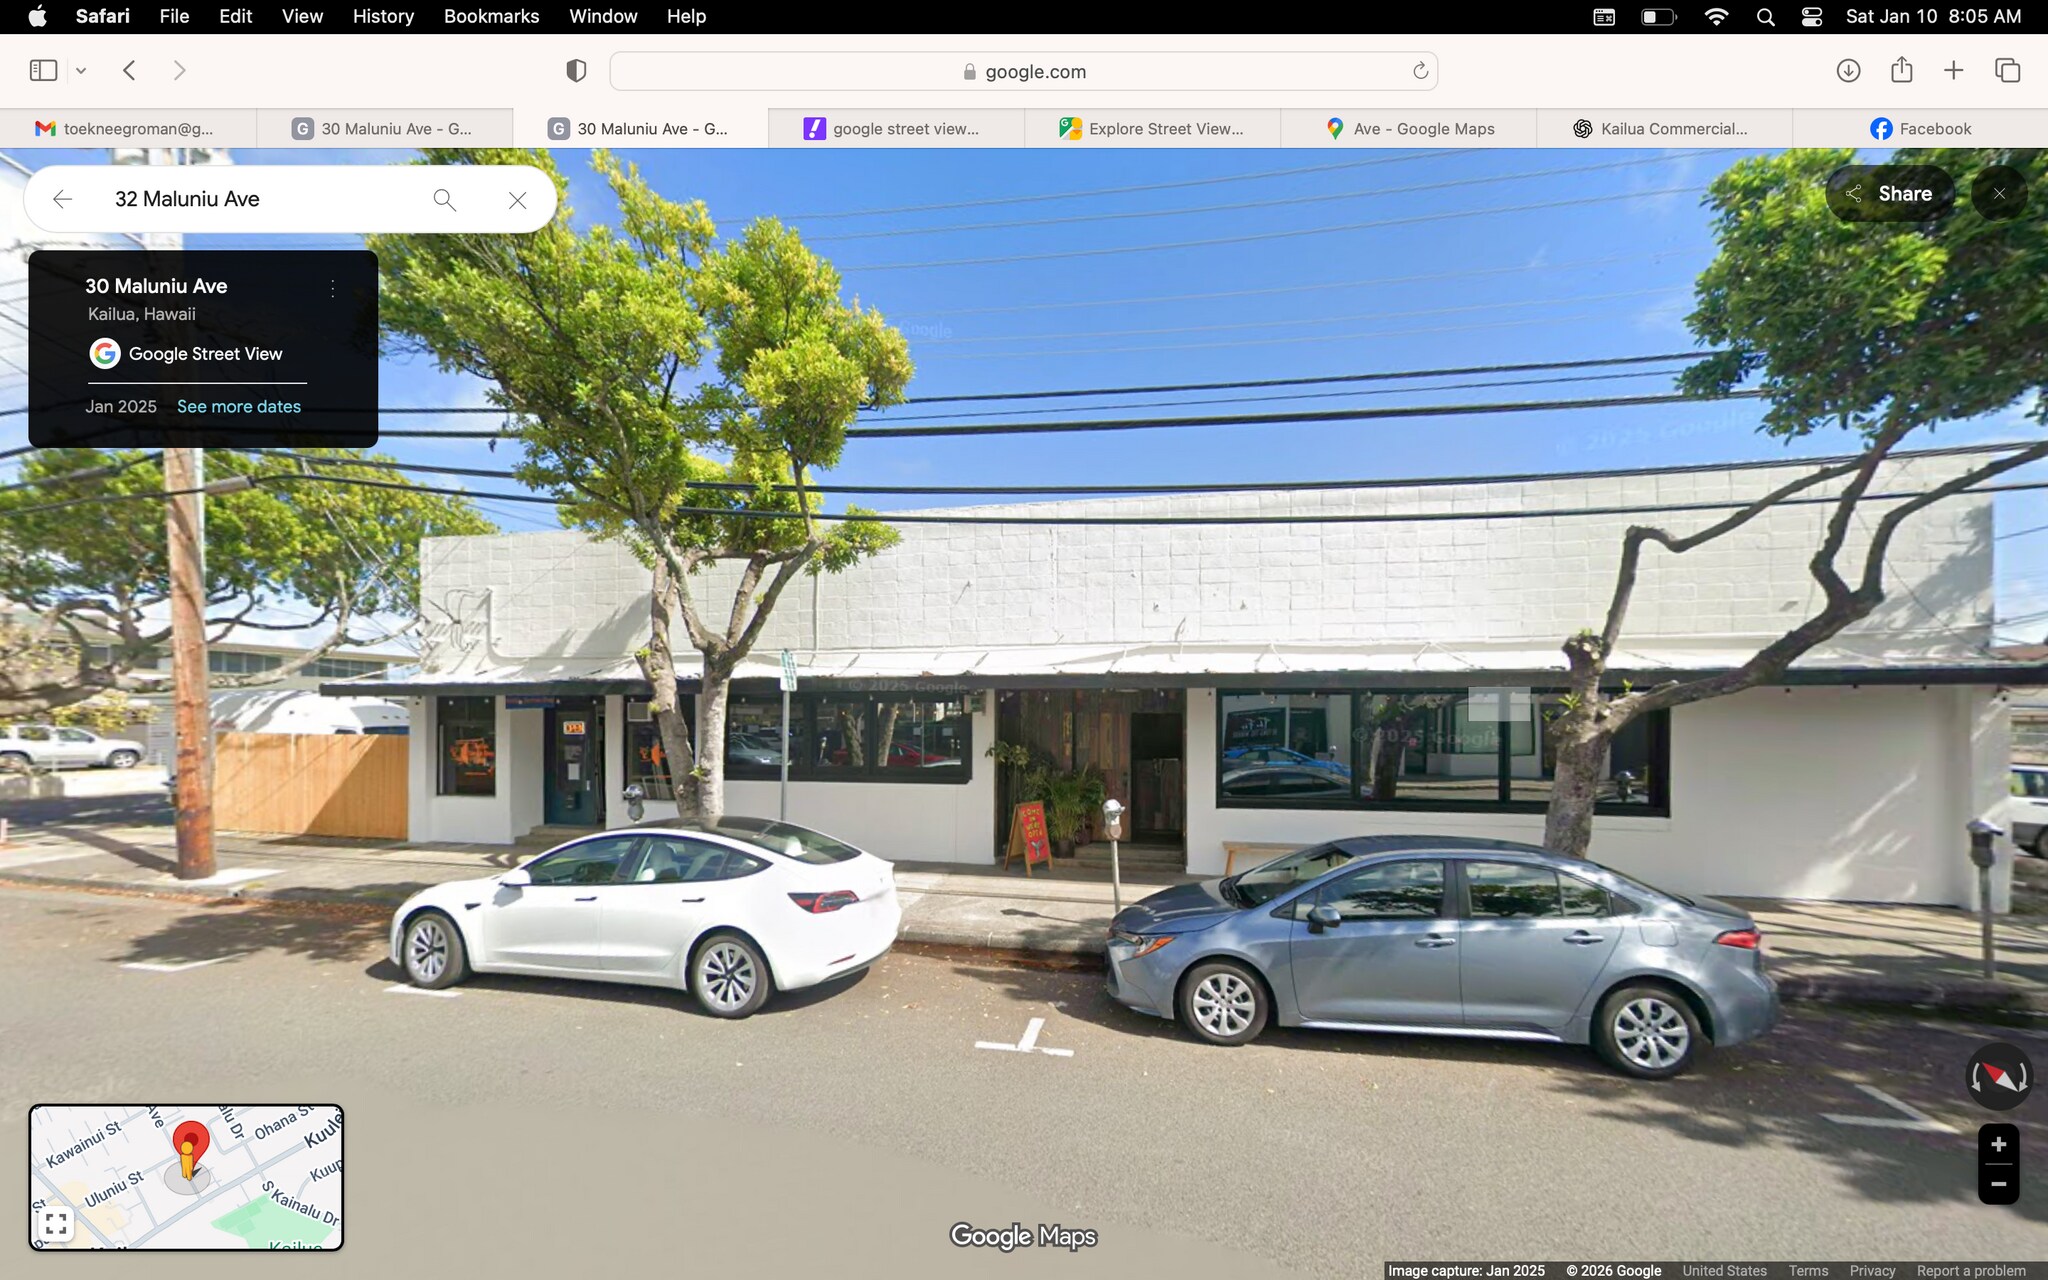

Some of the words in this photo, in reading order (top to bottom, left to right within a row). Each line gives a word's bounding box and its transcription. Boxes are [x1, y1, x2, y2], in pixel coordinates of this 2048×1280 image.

[76, 8, 130, 23] Safari
[161, 8, 189, 23] File
[220, 8, 253, 23] Edit
[282, 8, 324, 23] View
[354, 8, 415, 27] History
[445, 8, 539, 23] Bookmarks
[570, 8, 638, 23] Window
[668, 8, 706, 27] Help
[1847, 9, 1874, 23] Sat
[1880, 9, 1909, 23] Jan
[1917, 9, 1937, 23] 10
[1949, 9, 1988, 23] 8:05
[1993, 9, 2021, 23] AM
[986, 64, 1086, 82] google.com
[64, 121, 213, 138] toekneegroman@g...
[298, 123, 308, 135] G
[322, 122, 341, 136] 30
[346, 121, 402, 136] Maluniu
[406, 122, 433, 136] Ave
[554, 123, 564, 135] G
[578, 122, 597, 136] 30
[602, 121, 658, 136] Maluniu
[662, 122, 689, 136] Ave
[834, 122, 883, 138] google
[888, 123, 931, 136] street
[934, 121, 979, 136] view...
[1090, 121, 1144, 138] Explore
[1148, 122, 1192, 136] Street
[1196, 121, 1244, 136] View...
[1354, 122, 1381, 136] Ave
[1398, 121, 1450, 138] Google
[1456, 122, 1496, 138] Maps
[1602, 121, 1645, 136] Kailua
[1650, 121, 1748, 136] Commercial...
[1876, 121, 1887, 140] f
[1901, 121, 1973, 136] Facebook
